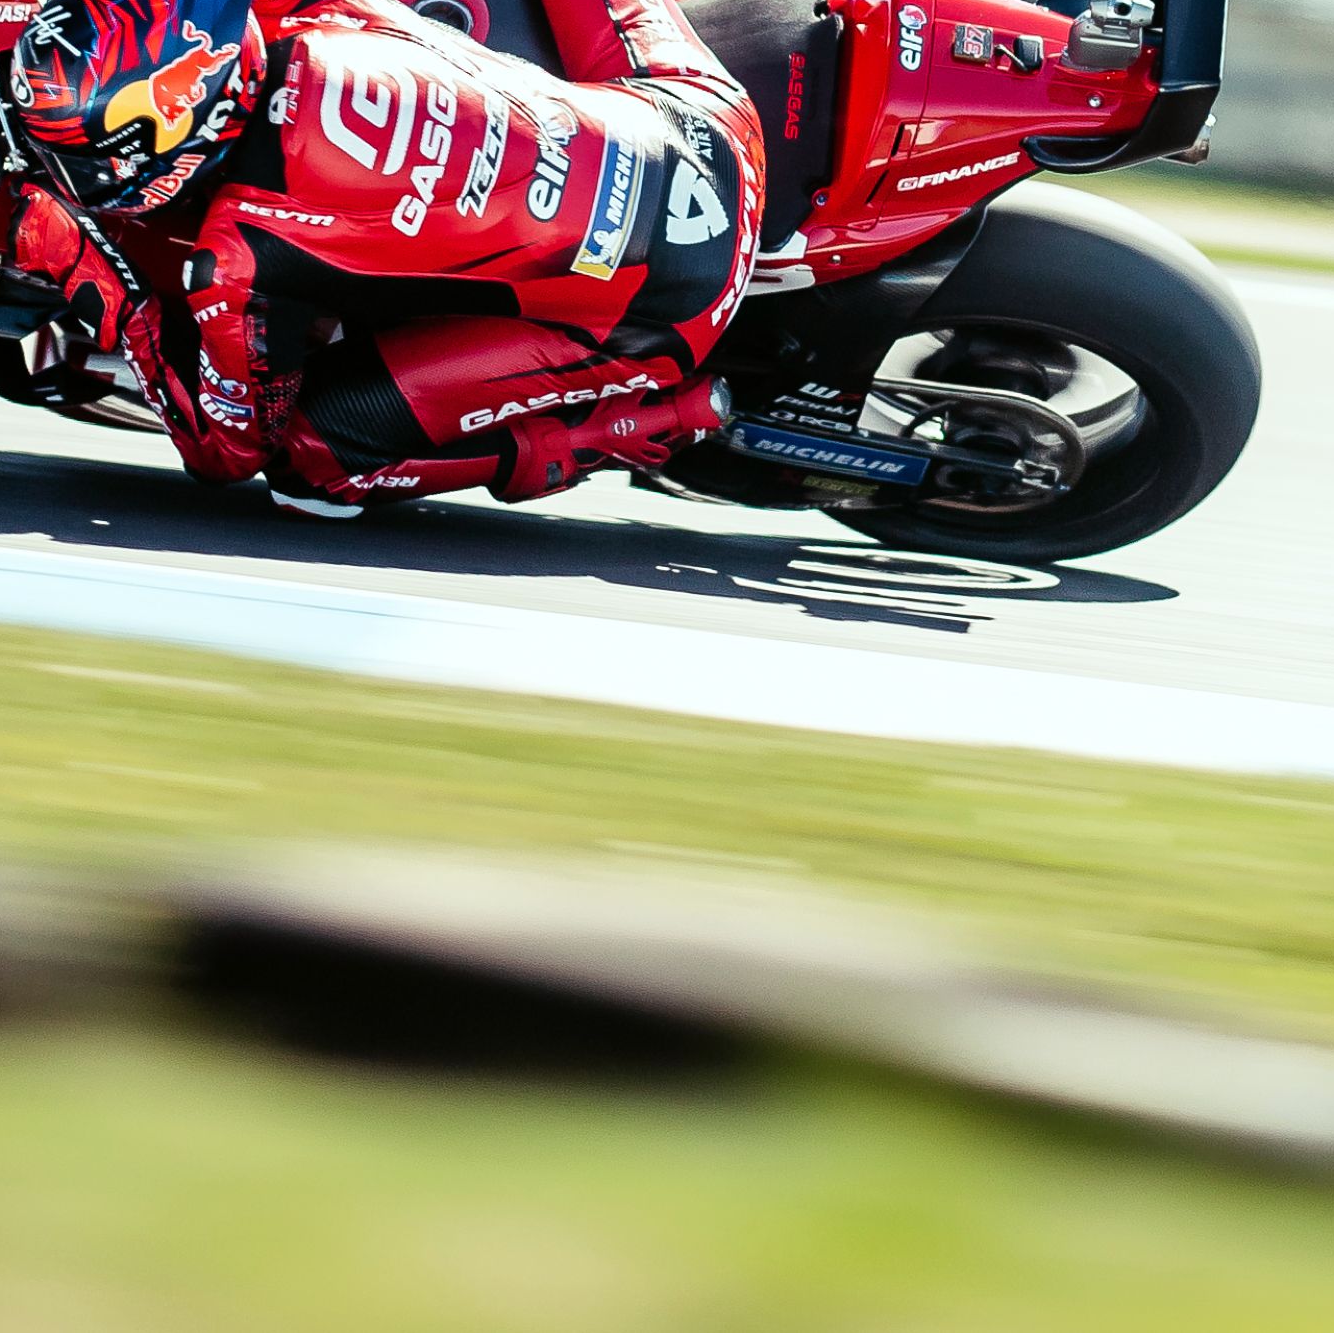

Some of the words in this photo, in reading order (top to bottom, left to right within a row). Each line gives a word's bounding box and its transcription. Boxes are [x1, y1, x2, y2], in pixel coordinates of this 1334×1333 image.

[899, 28, 925, 72] elf
[963, 24, 986, 59] 37
[784, 52, 806, 141] GASGAS
[151, 153, 208, 197] Bull
[391, 77, 459, 237] GASG
[459, 373, 660, 433] GASGAS
[754, 438, 907, 474] MICHELIN
